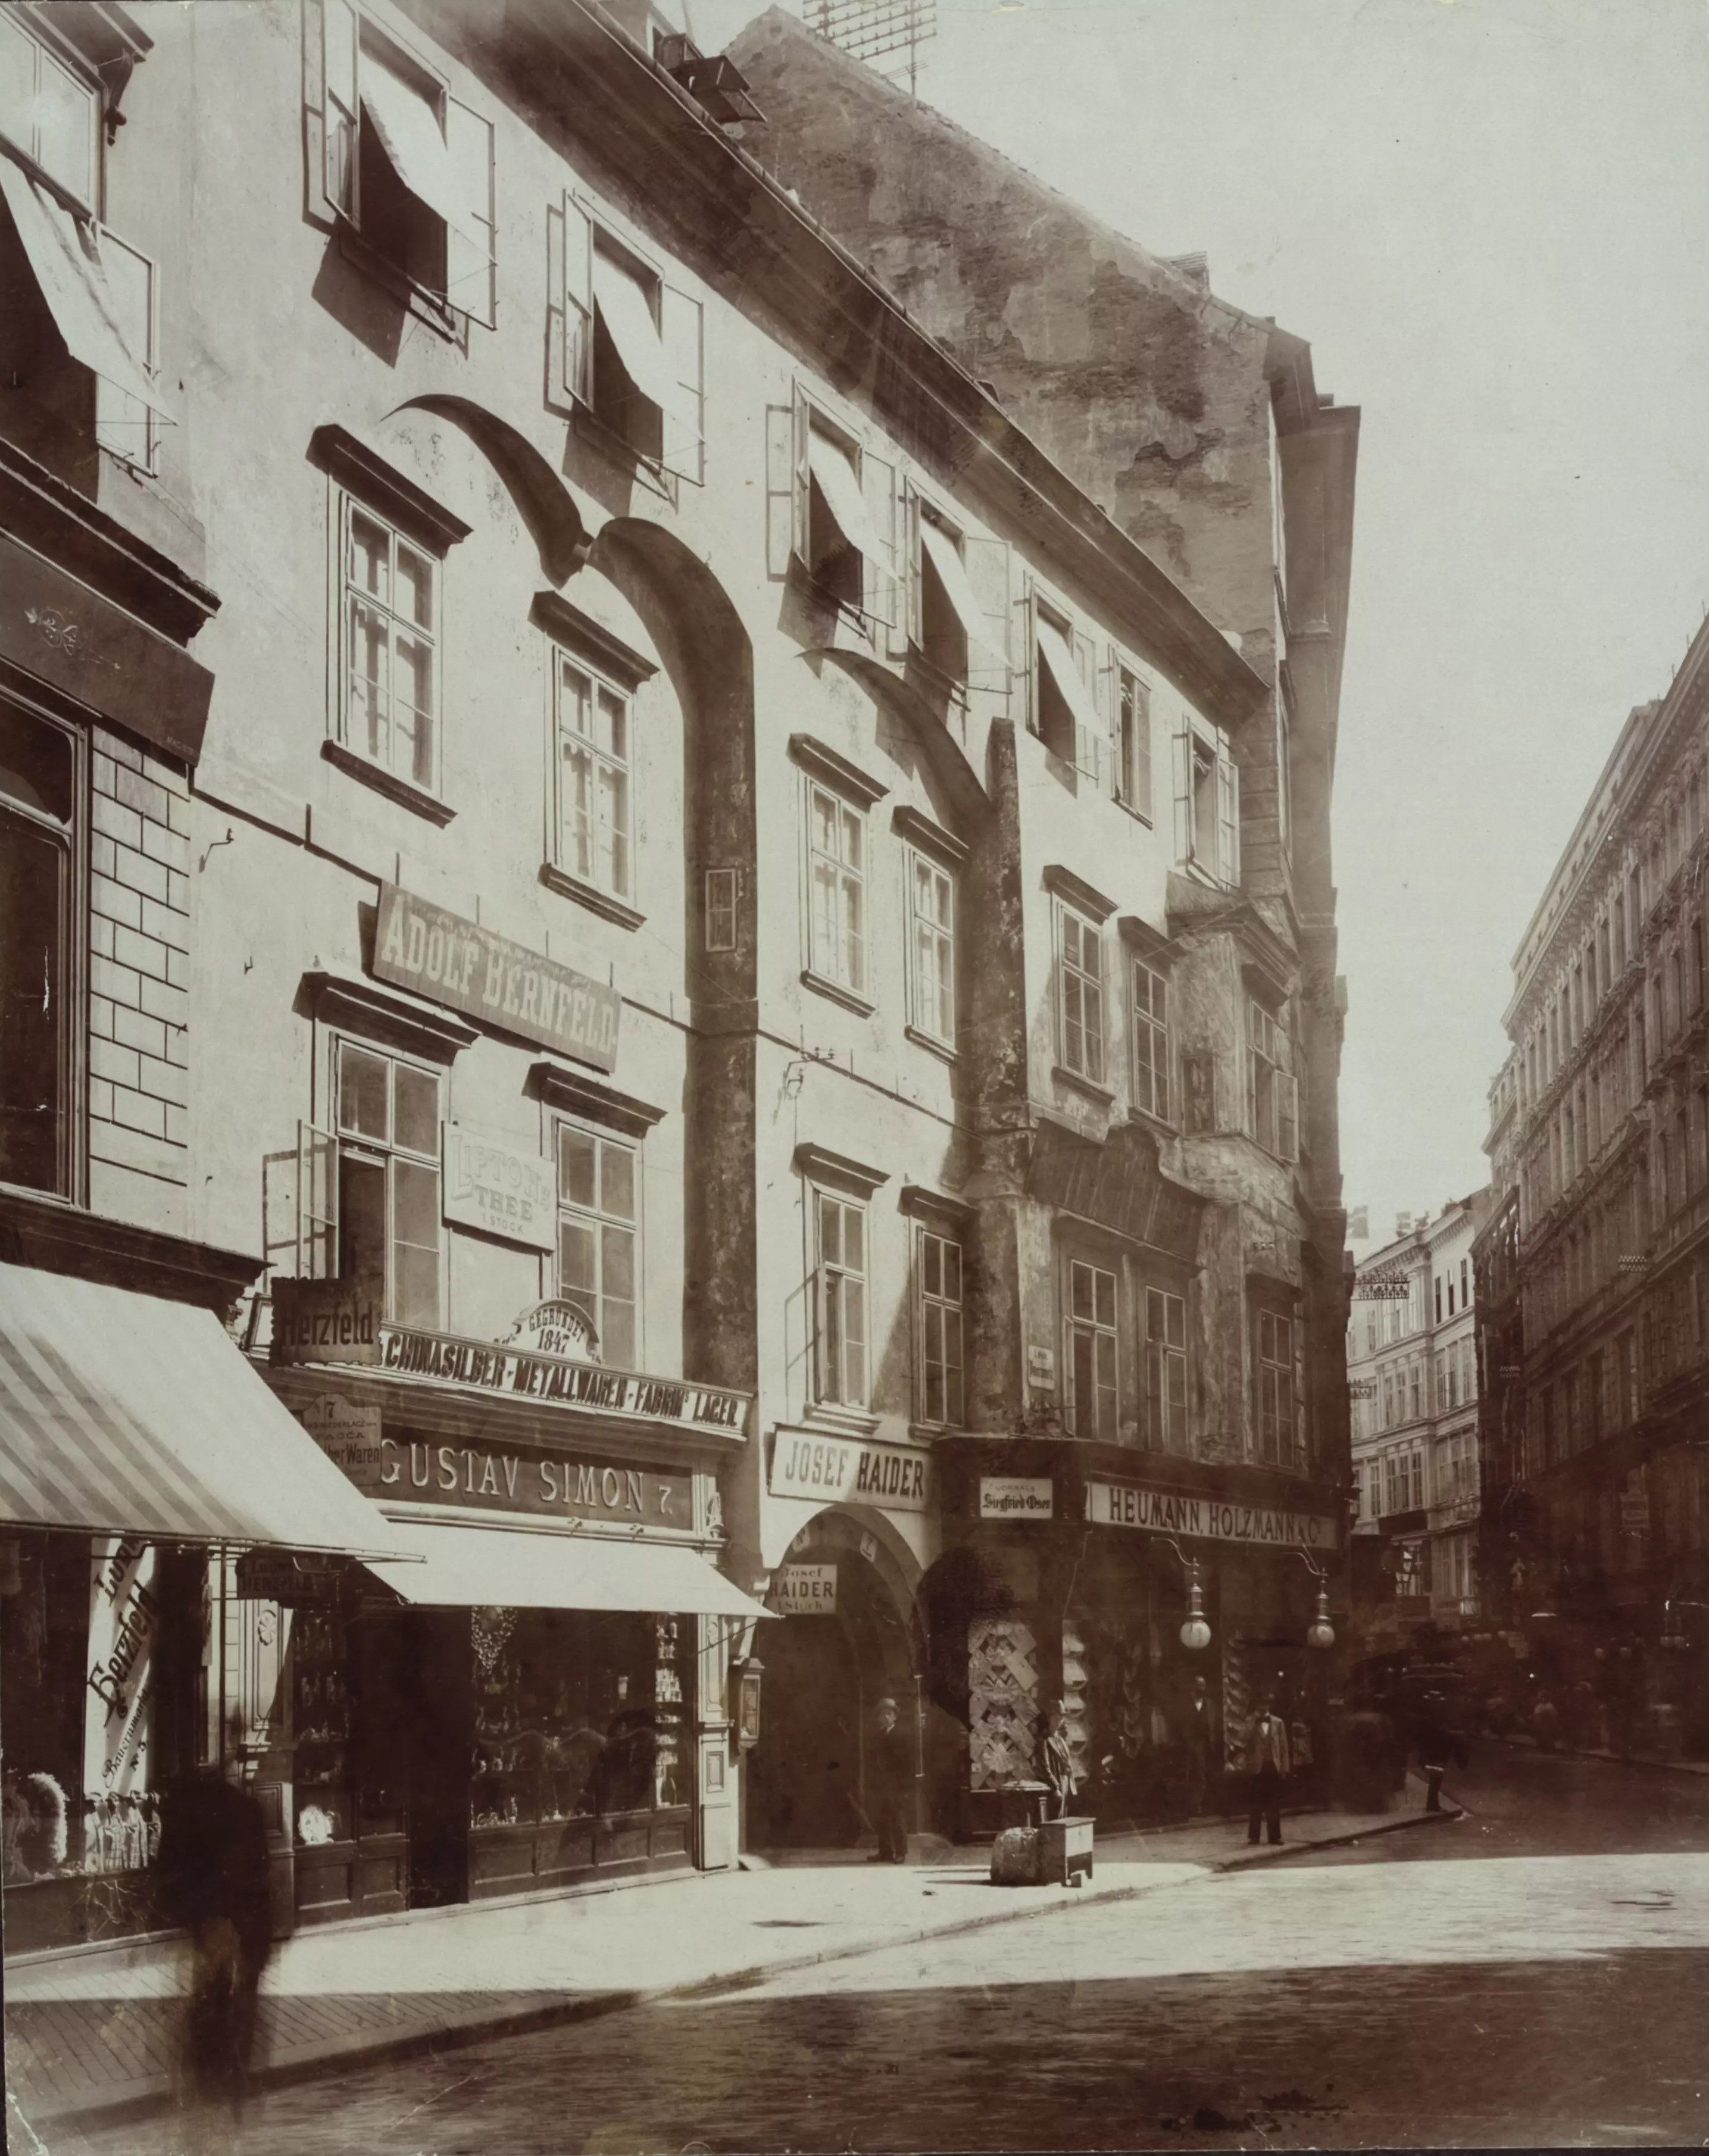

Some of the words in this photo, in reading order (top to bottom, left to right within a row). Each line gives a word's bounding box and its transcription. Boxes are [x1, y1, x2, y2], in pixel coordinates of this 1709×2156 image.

[380, 893, 480, 996] ADOLF
[281, 1299, 374, 1346] Herzfeld
[529, 1307, 585, 1343] GEGRÜNDET
[536, 1327, 570, 1354] 1847
[692, 1392, 739, 1427] LAGER
[345, 1443, 380, 1464] Waren
[785, 1441, 849, 1487] JOSEF
[856, 1451, 924, 1499] HAIDER
[381, 1438, 519, 1499] GUSTAV
[538, 1461, 643, 1514] SIMON
[1208, 1504, 1295, 1543] HOLZMANN
[770, 1580, 833, 1598] HAIDER
